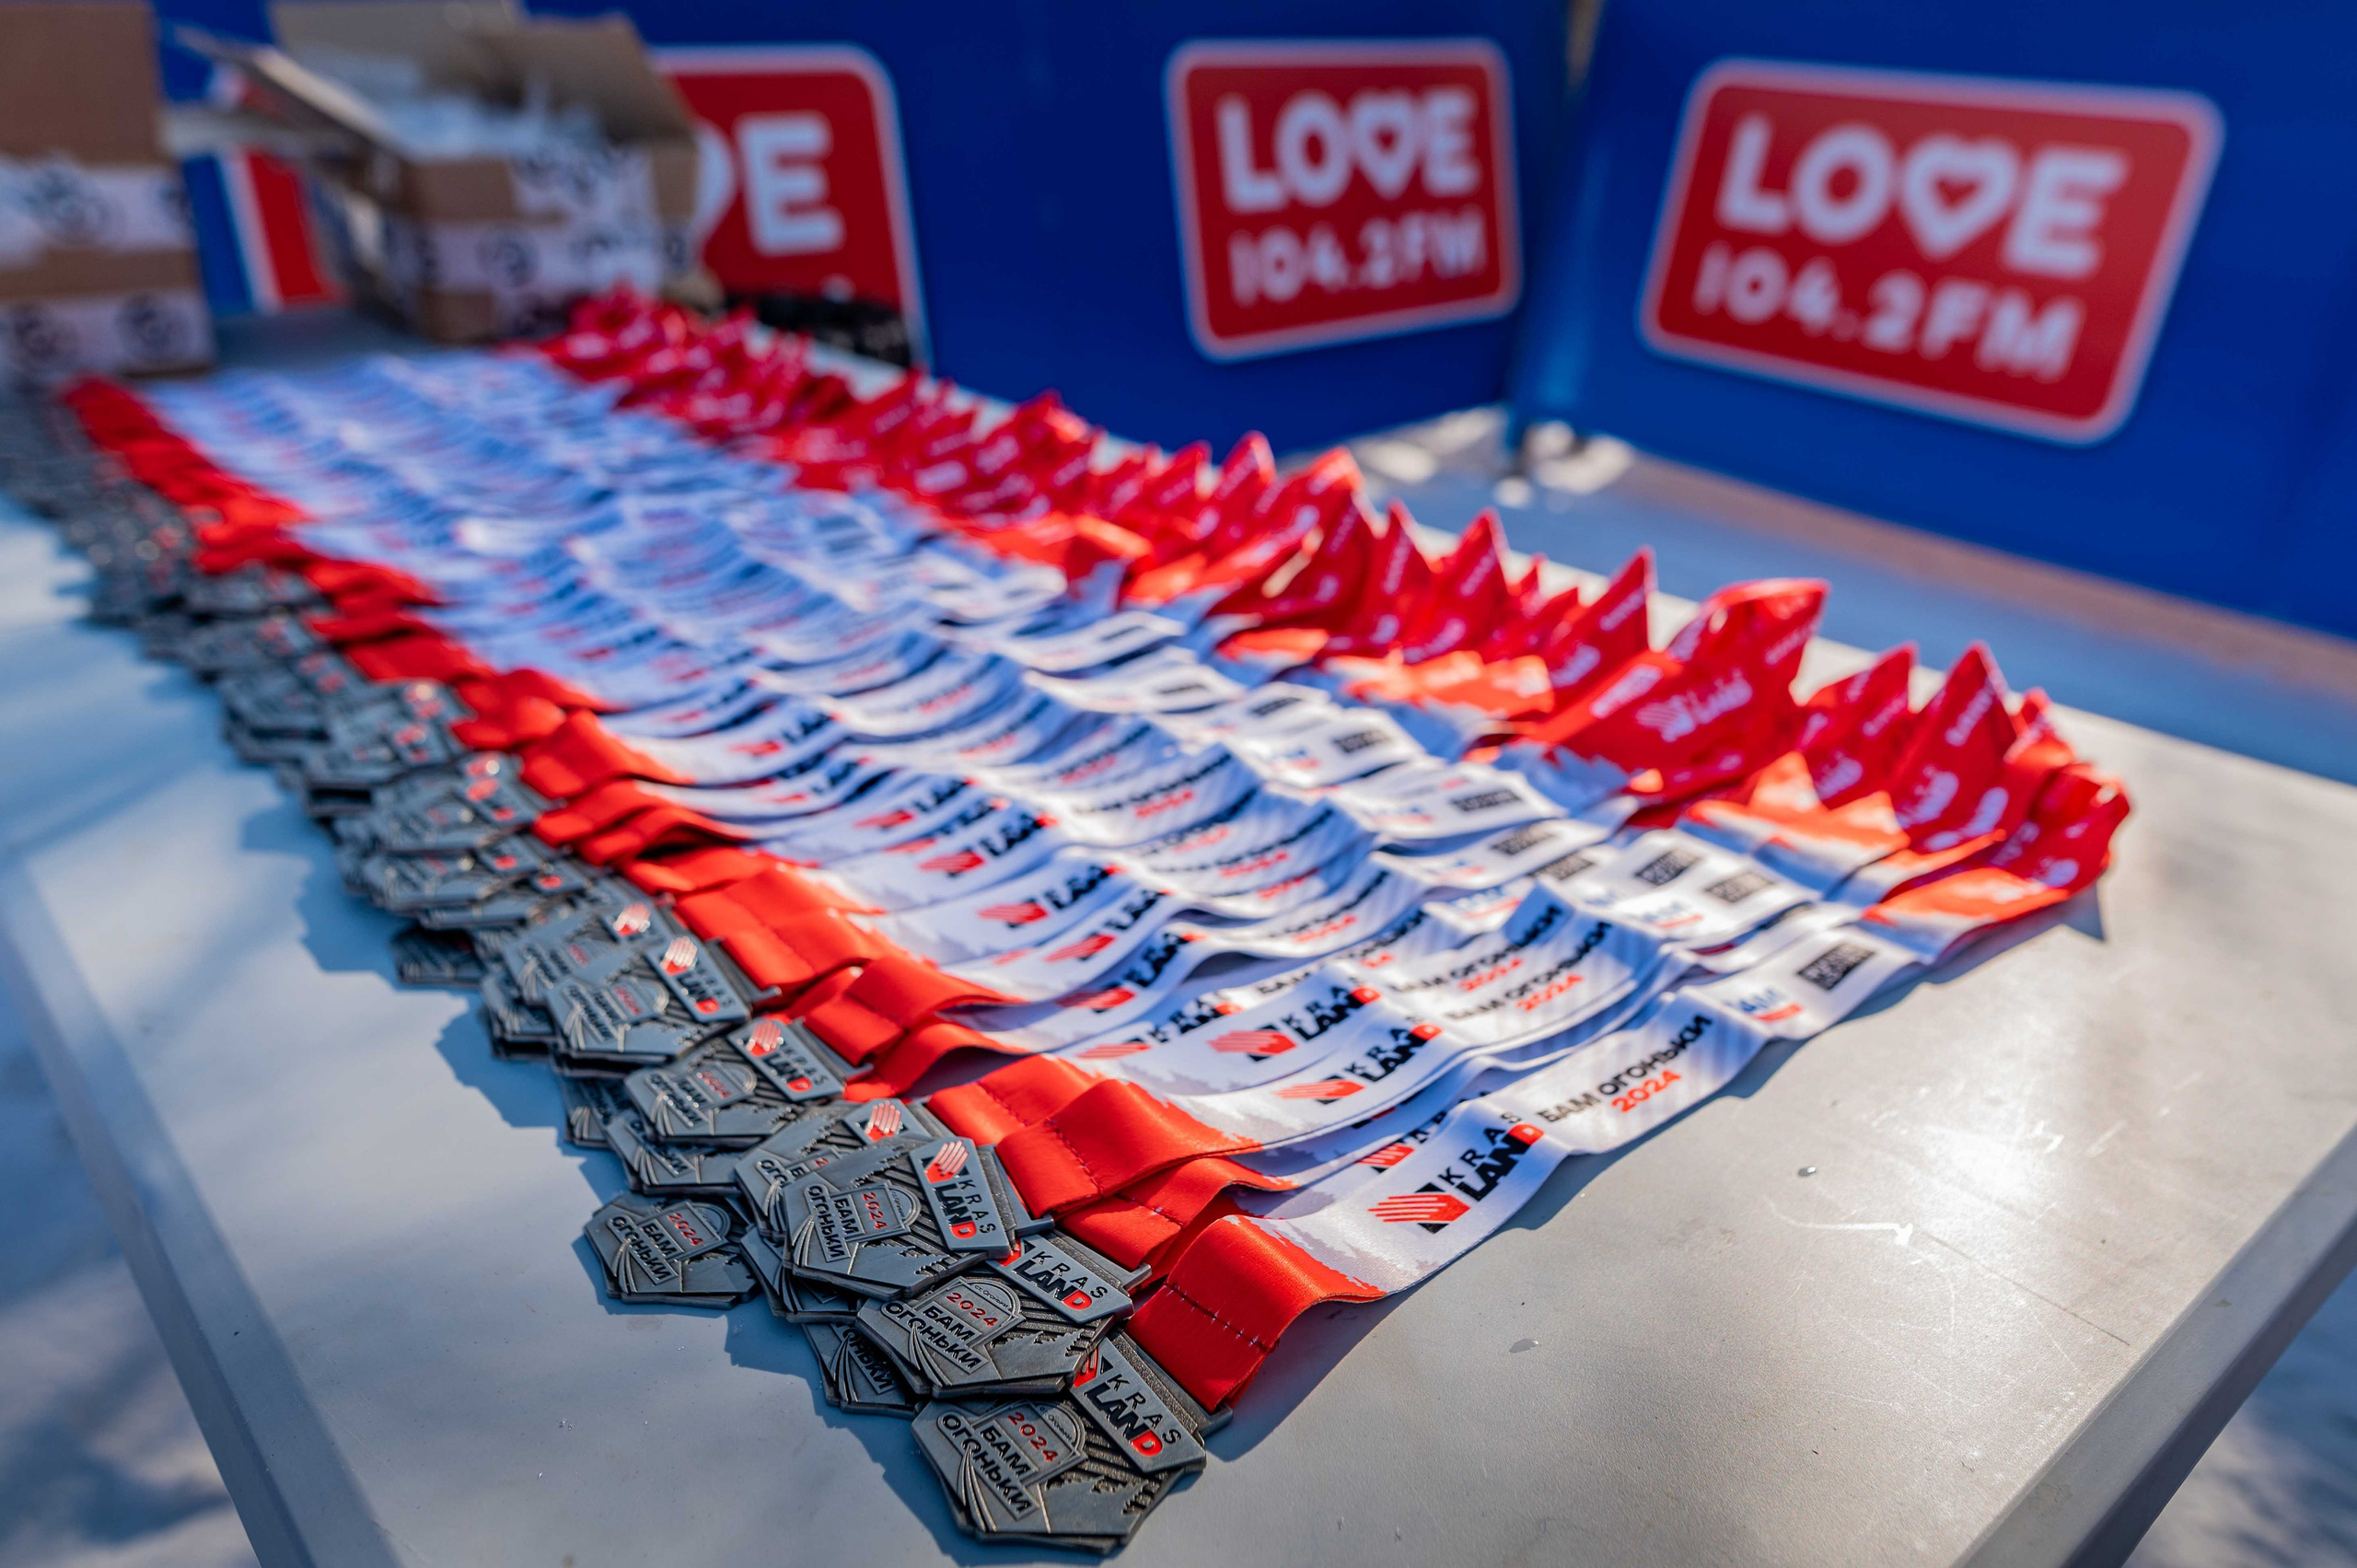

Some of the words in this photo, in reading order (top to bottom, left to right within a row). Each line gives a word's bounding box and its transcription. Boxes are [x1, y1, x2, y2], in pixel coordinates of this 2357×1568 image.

[1218, 86, 1480, 212] LOVE
[1716, 112, 2129, 279] LOVE
[1693, 241, 2084, 382] 104.2FM
[1295, 985, 1381, 1040] LAND
[1357, 1023, 1443, 1082] LAND
[1536, 1093, 1601, 1123] БАМ
[1597, 1015, 1713, 1096] ОГОНЬКИ
[1611, 1069, 1681, 1113] 2024
[1438, 1112, 1522, 1186] KRAS
[1456, 1124, 1545, 1202] LAND
[667, 1213, 703, 1247] 2024
[807, 1184, 846, 1260] ОГОНЬКИ
[833, 1198, 860, 1236] БАМ
[863, 1192, 888, 1230] 2024
[933, 1183, 979, 1239] LAND
[958, 1179, 997, 1236] KRAS
[610, 1215, 672, 1282] ОГОНЬКИ
[642, 1223, 677, 1258] БАМ
[1012, 1260, 1094, 1311] LAND
[1032, 1250, 1109, 1300] KRAS
[884, 1300, 983, 1371] ОГОНЬКИ
[922, 1304, 973, 1342] БАМ
[945, 1291, 999, 1328] 2024
[1008, 1411, 1059, 1463] 2024
[1083, 1382, 1164, 1458] LAND
[1108, 1373, 1182, 1446] KRAS
[941, 1413, 1033, 1515] ОГОНЬКИ
[980, 1423, 1035, 1479] БАМ
